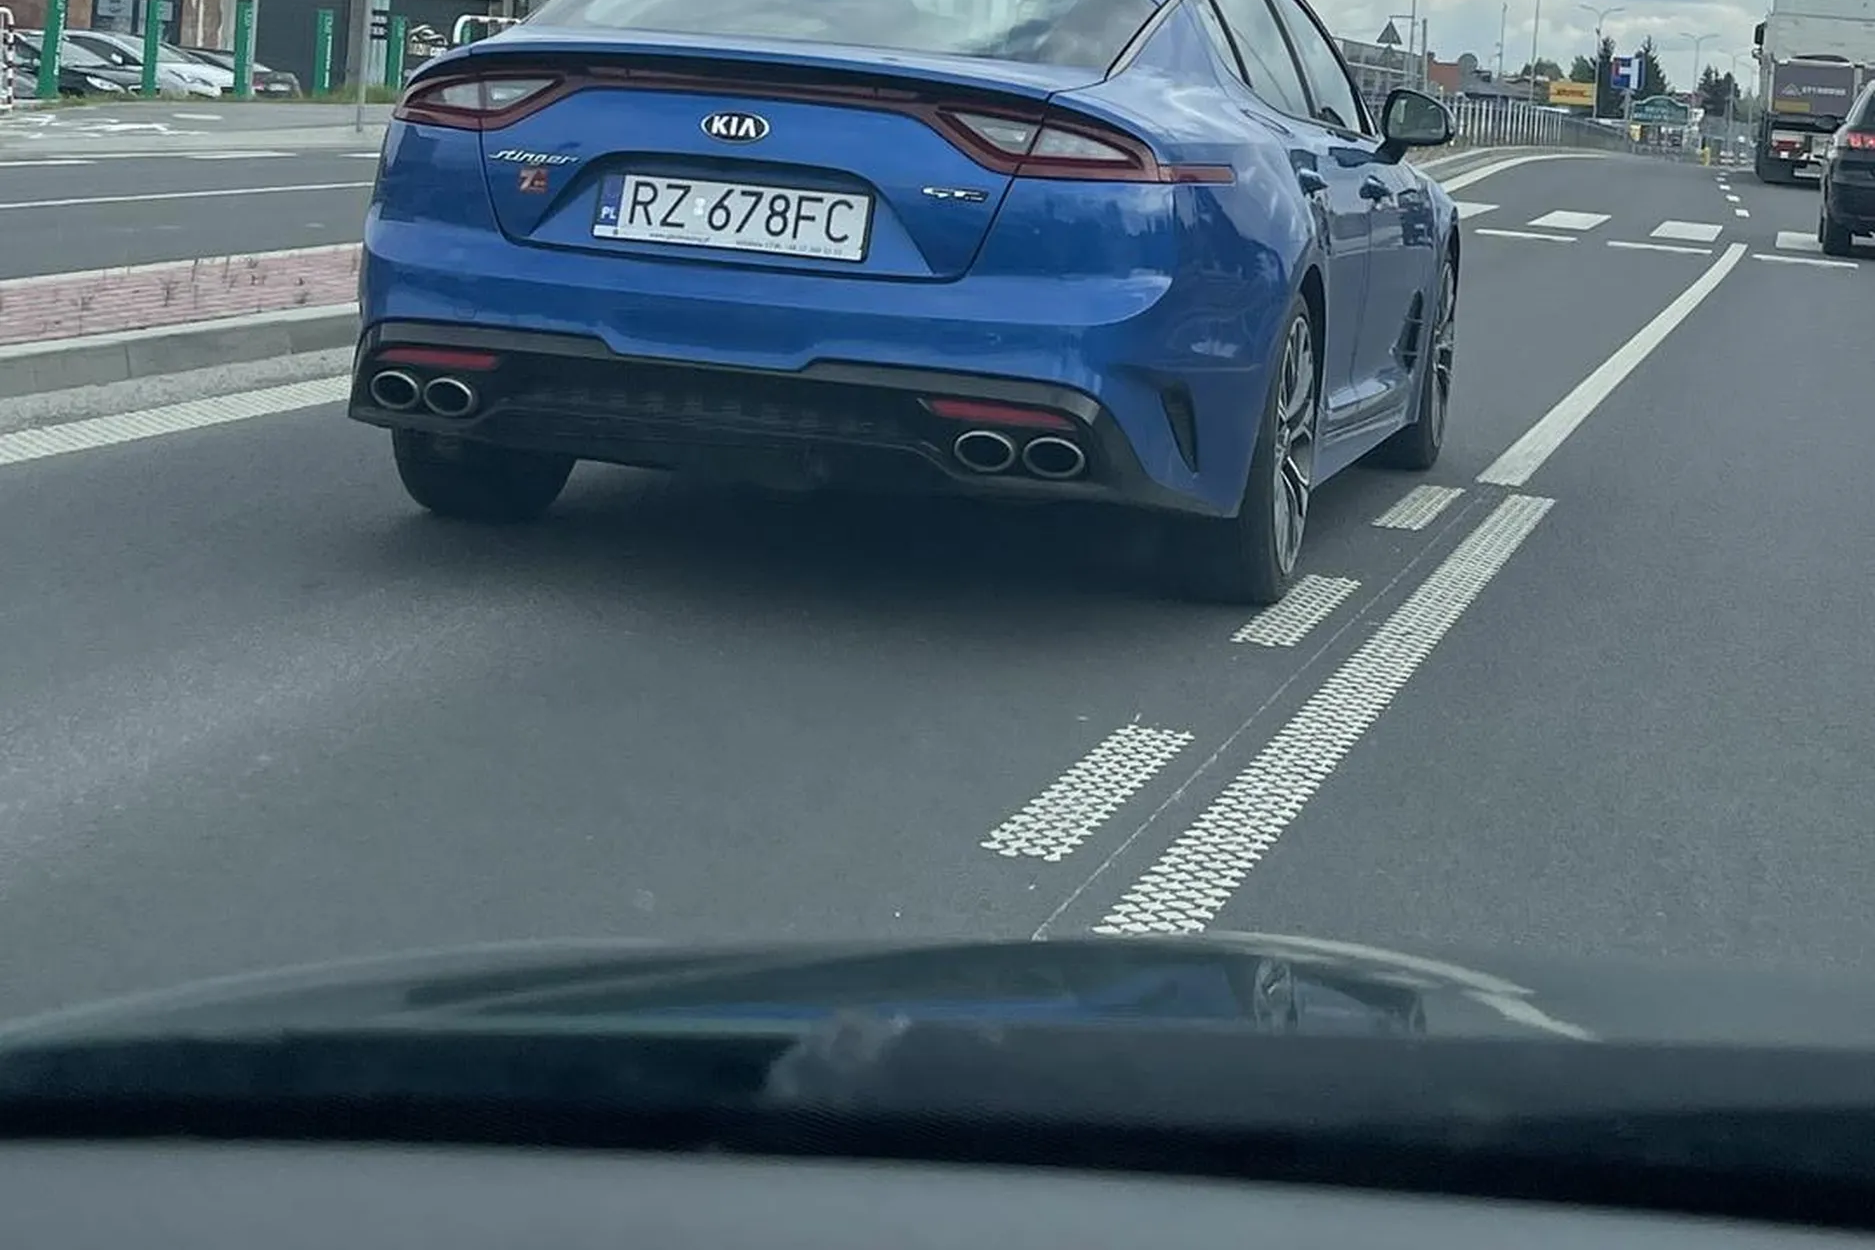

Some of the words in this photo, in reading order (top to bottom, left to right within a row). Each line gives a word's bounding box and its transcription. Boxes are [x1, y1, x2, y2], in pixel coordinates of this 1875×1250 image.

[711, 115, 757, 138] KIA
[601, 205, 617, 220] PL
[628, 180, 692, 229] RZ
[707, 188, 854, 244] 678FC
